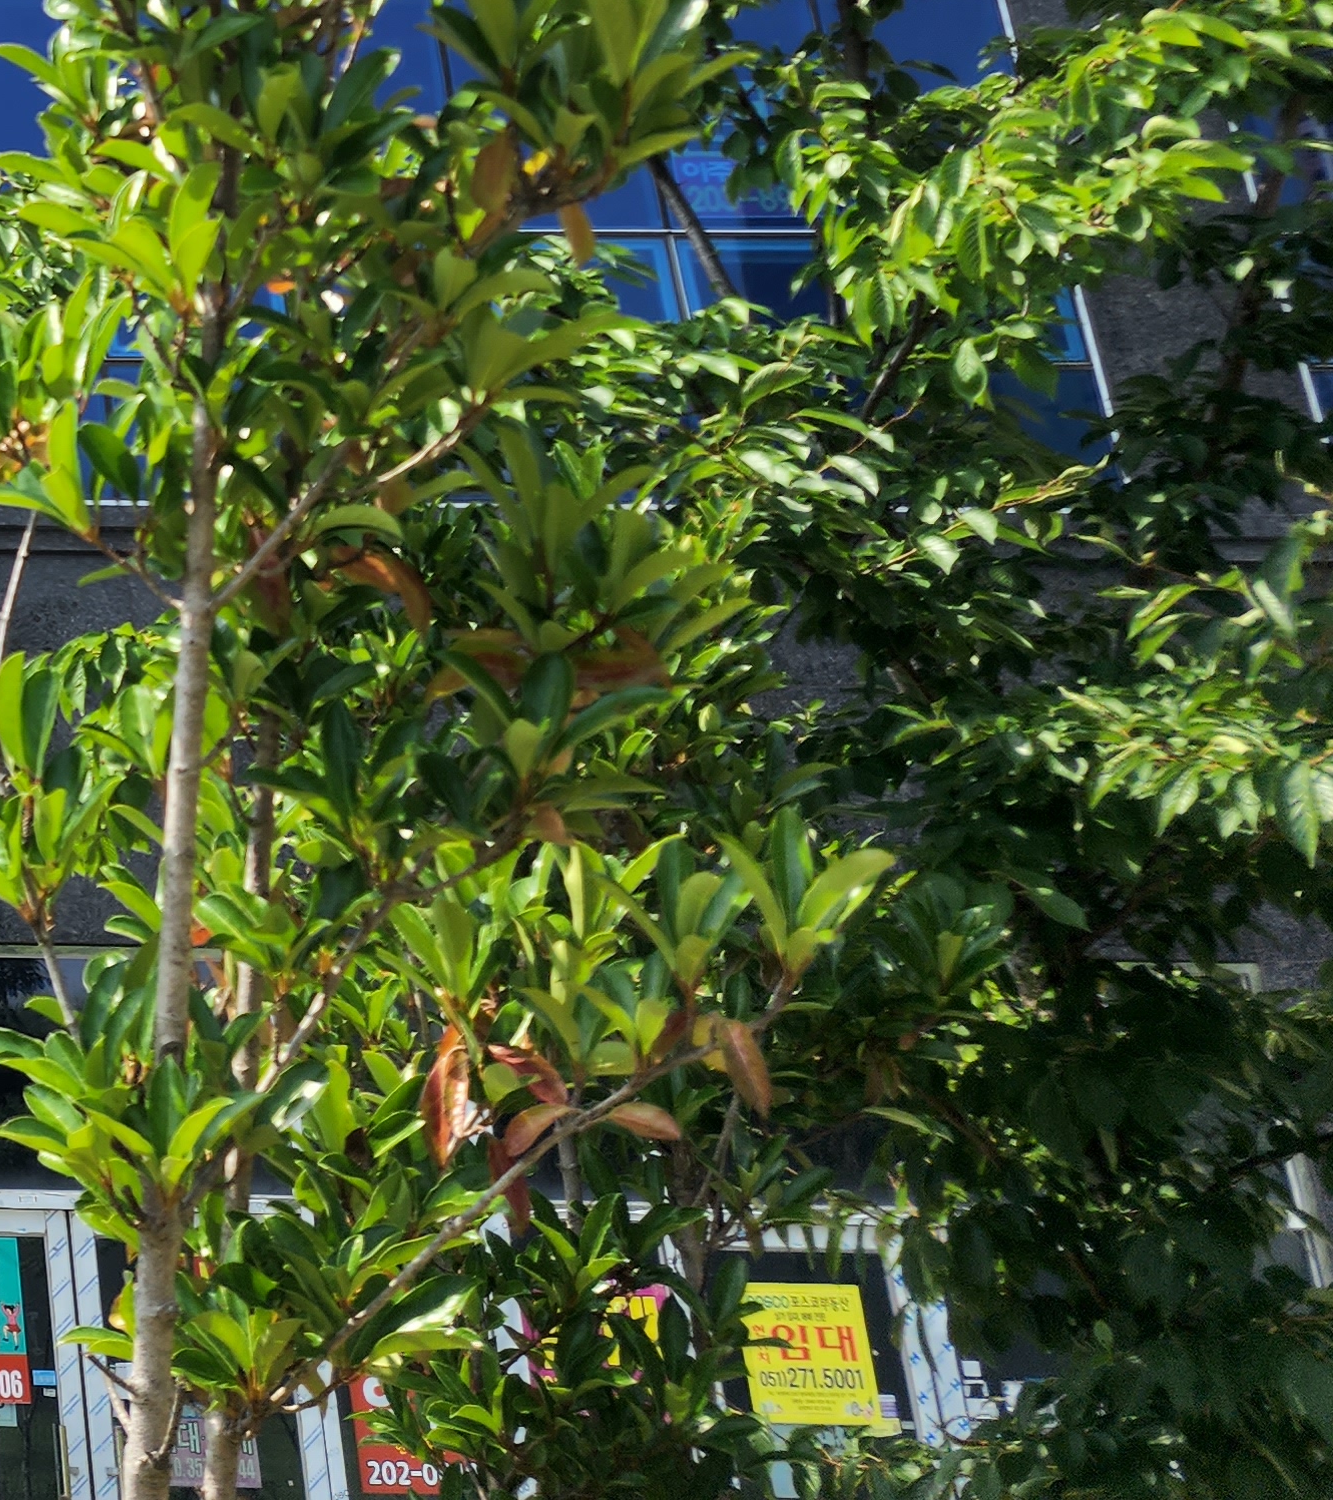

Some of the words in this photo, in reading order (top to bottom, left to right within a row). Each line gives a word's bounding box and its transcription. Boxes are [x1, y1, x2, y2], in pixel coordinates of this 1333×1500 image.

[770, 1324, 859, 1362] 임대
[760, 1367, 864, 1389] 051)271.5001
[367, 1460, 458, 1486] 202-0
